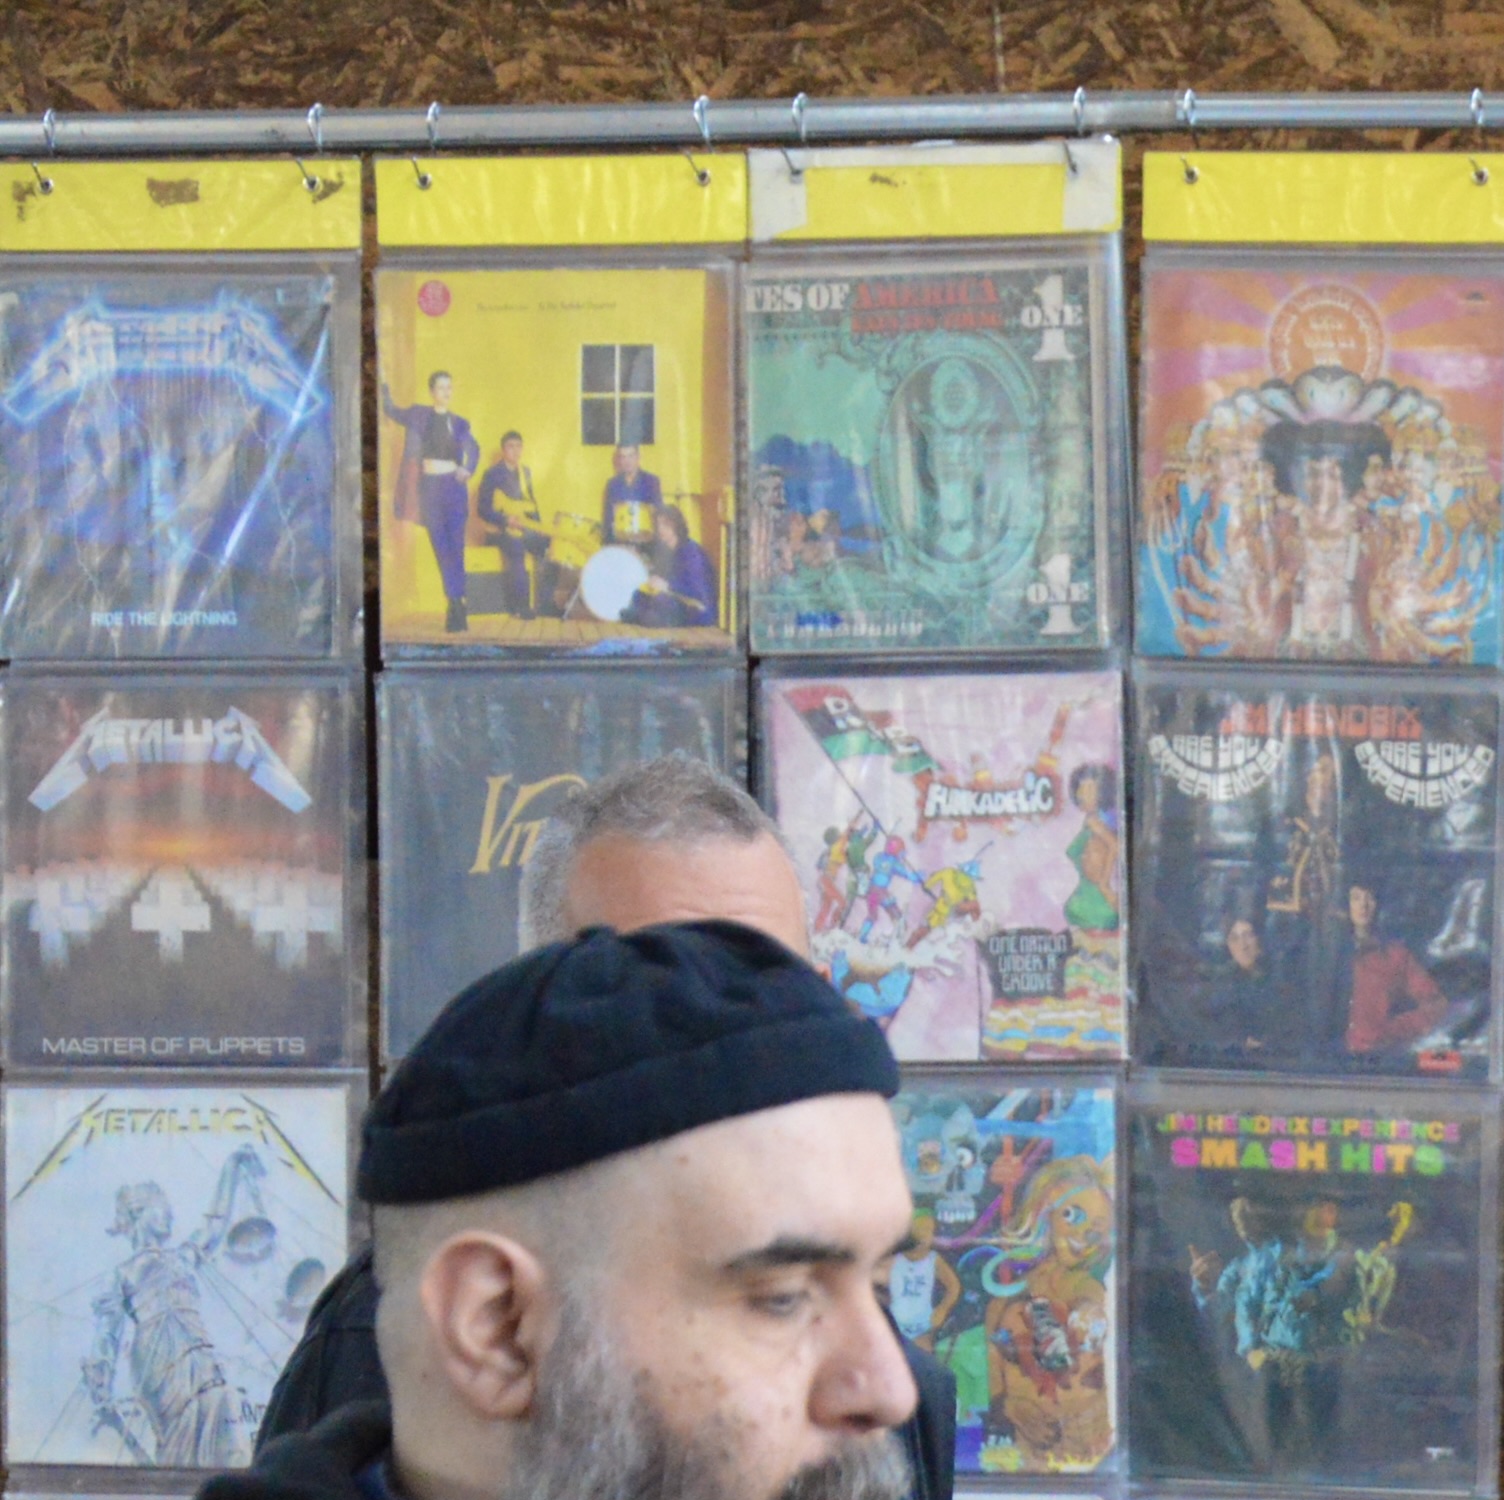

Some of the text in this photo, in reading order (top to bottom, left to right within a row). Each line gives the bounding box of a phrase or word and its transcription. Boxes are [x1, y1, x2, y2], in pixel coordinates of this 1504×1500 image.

[806, 282, 850, 311] OF
[1020, 304, 1083, 328] ONE
[1026, 582, 1090, 606] ONE
[1282, 703, 1423, 740] HENDRIX
[27, 706, 312, 813] METALLICA
[1171, 733, 1261, 770] ARE YOU
[1379, 740, 1470, 777] ARE YOU
[1353, 740, 1496, 810] EXPERIENCED
[41, 1035, 306, 1057] MASTER OF PUPPETS
[1156, 1112, 1460, 1143] JIMI HENDRIX EXPERIENCE
[13, 1093, 345, 1208] METALLICA
[1170, 1137, 1446, 1176] SMASH HITS
